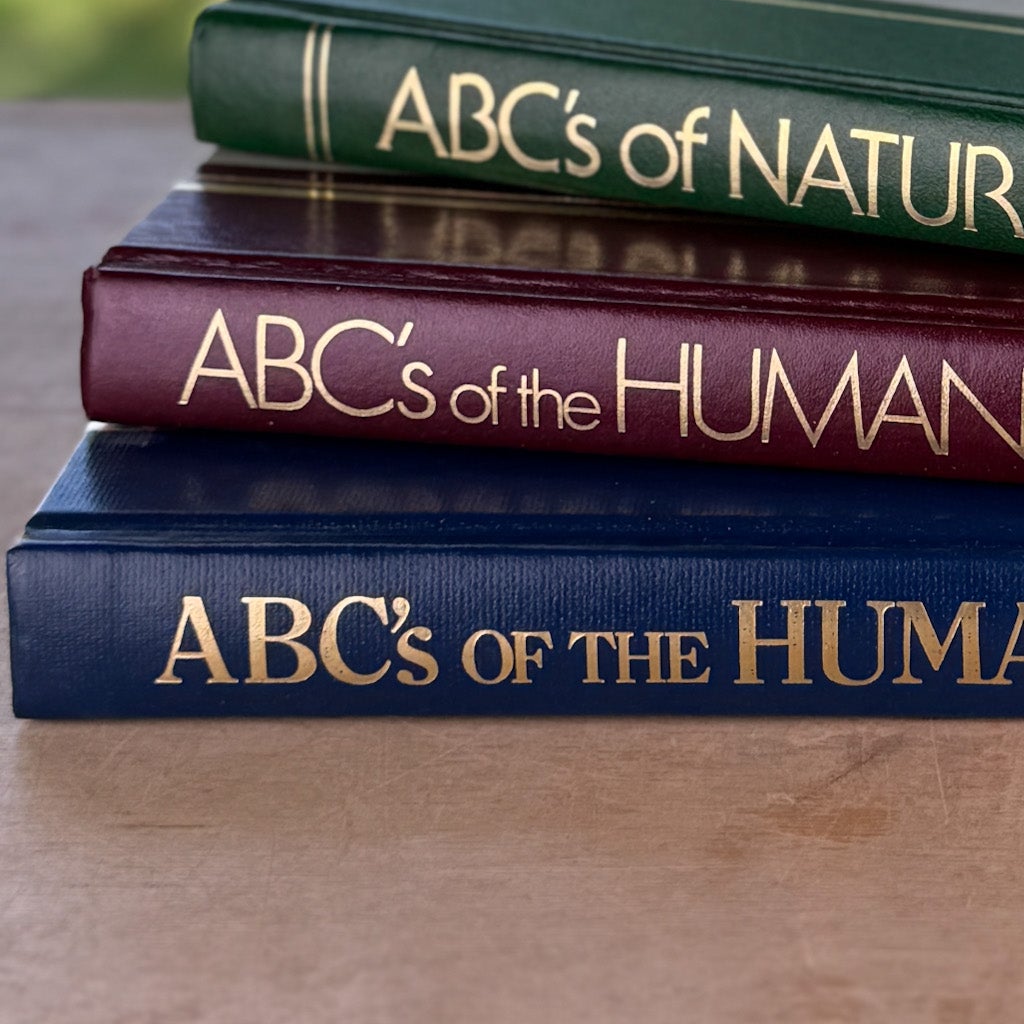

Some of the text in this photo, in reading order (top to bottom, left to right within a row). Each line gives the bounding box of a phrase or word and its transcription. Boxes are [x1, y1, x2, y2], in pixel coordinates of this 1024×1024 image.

[376, 66, 600, 177] ABC's
[620, 106, 711, 192] of
[177, 309, 436, 420] ABC's
[449, 365, 507, 426] of
[517, 368, 601, 431] the
[155, 595, 439, 686] ABC's
[461, 629, 554, 684] OF
[567, 631, 711, 685] THE
